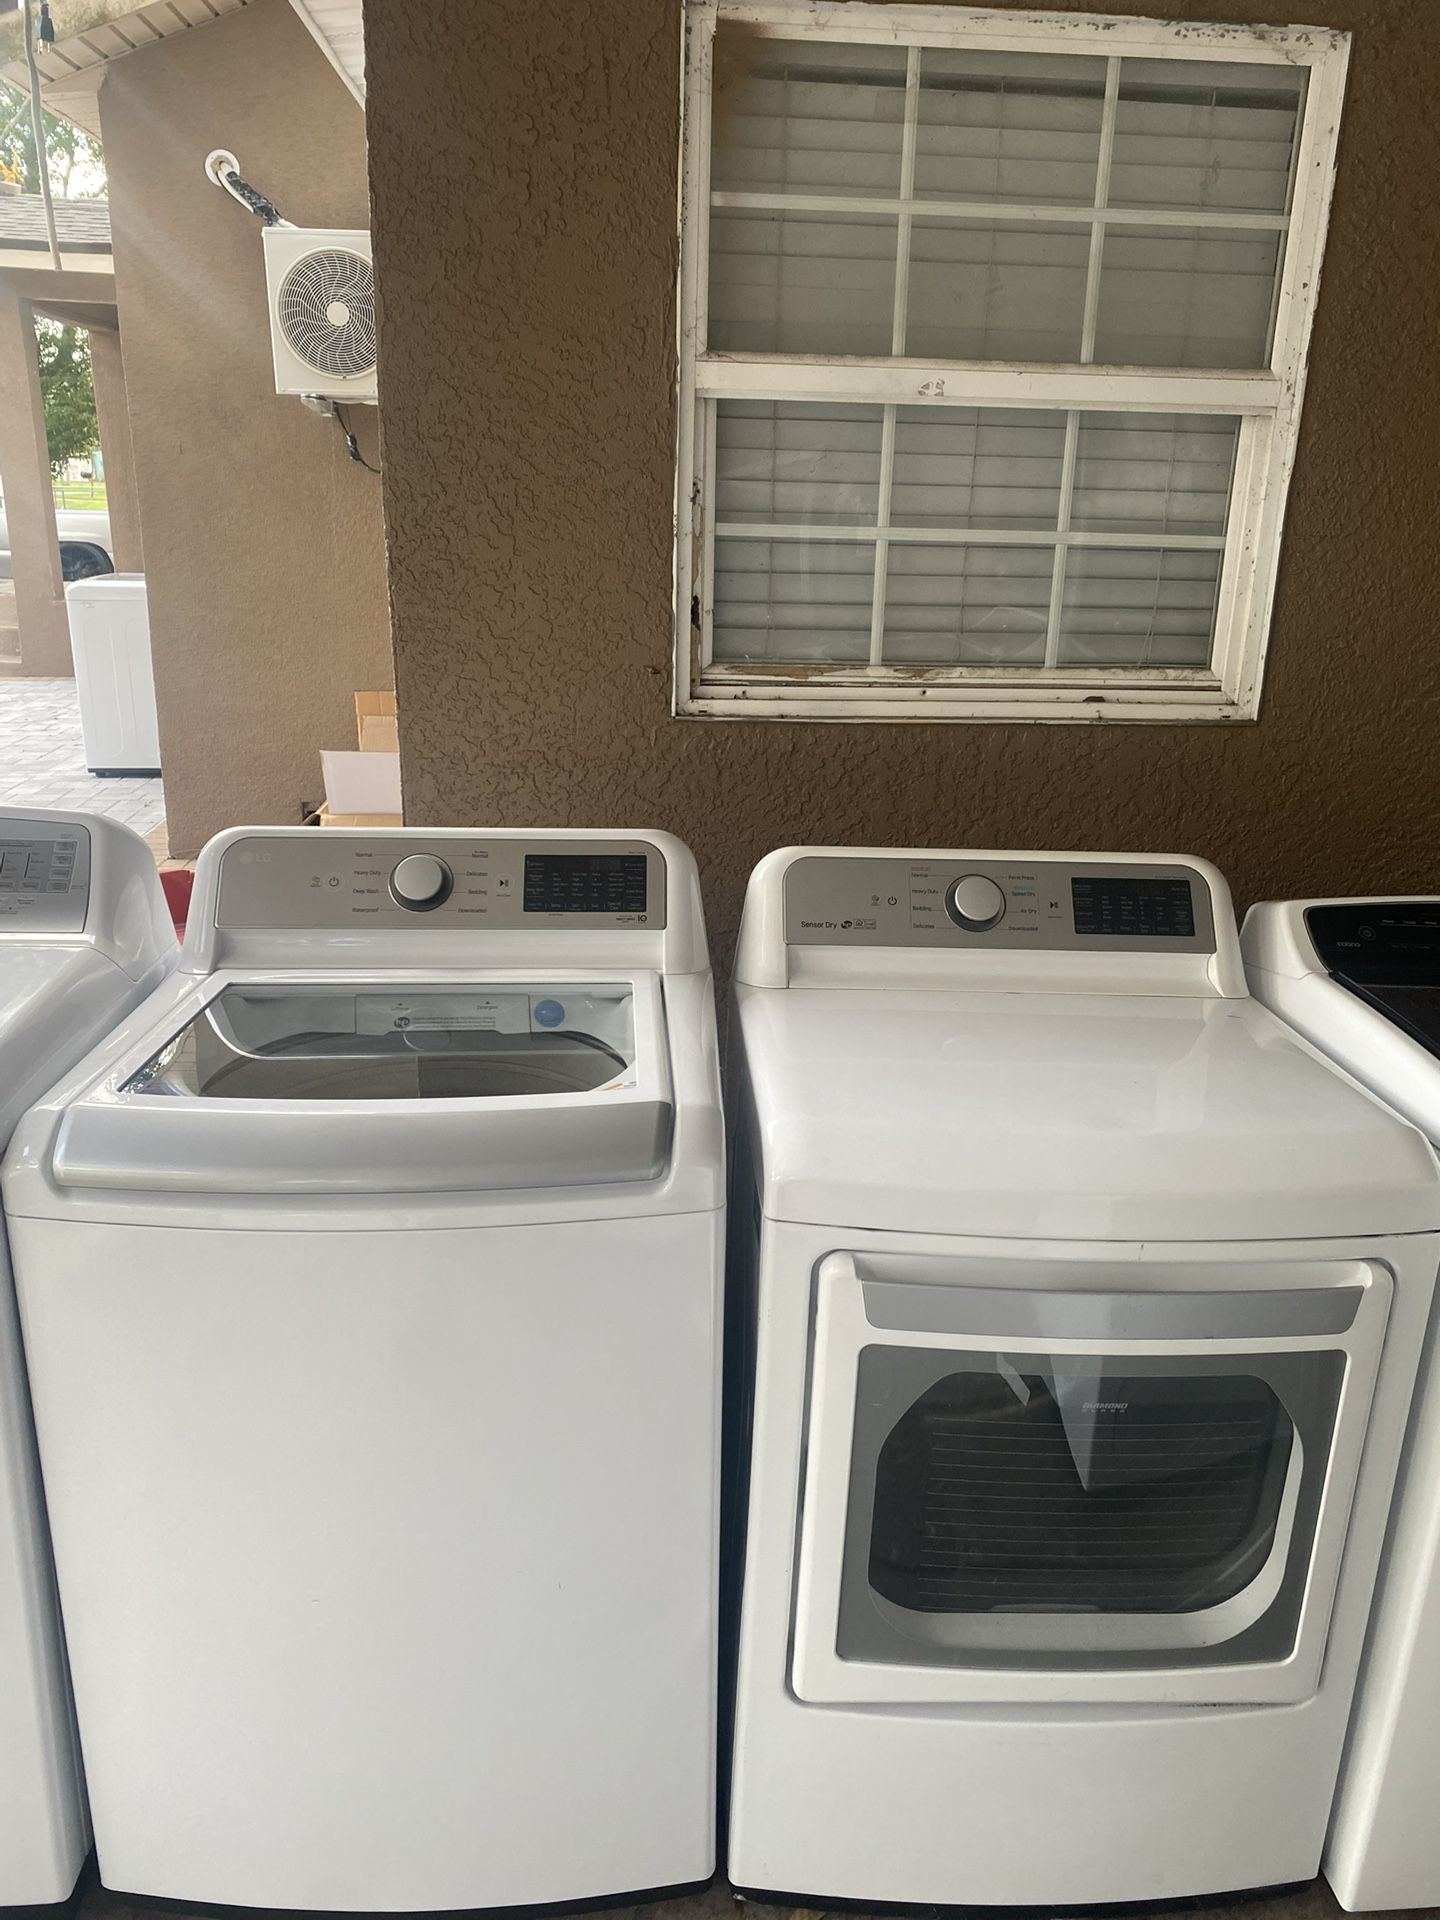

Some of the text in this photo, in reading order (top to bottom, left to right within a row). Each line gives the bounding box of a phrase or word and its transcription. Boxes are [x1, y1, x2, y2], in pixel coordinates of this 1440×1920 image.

[255, 853, 272, 863] LG
[800, 920, 838, 930] Sensor Dry
